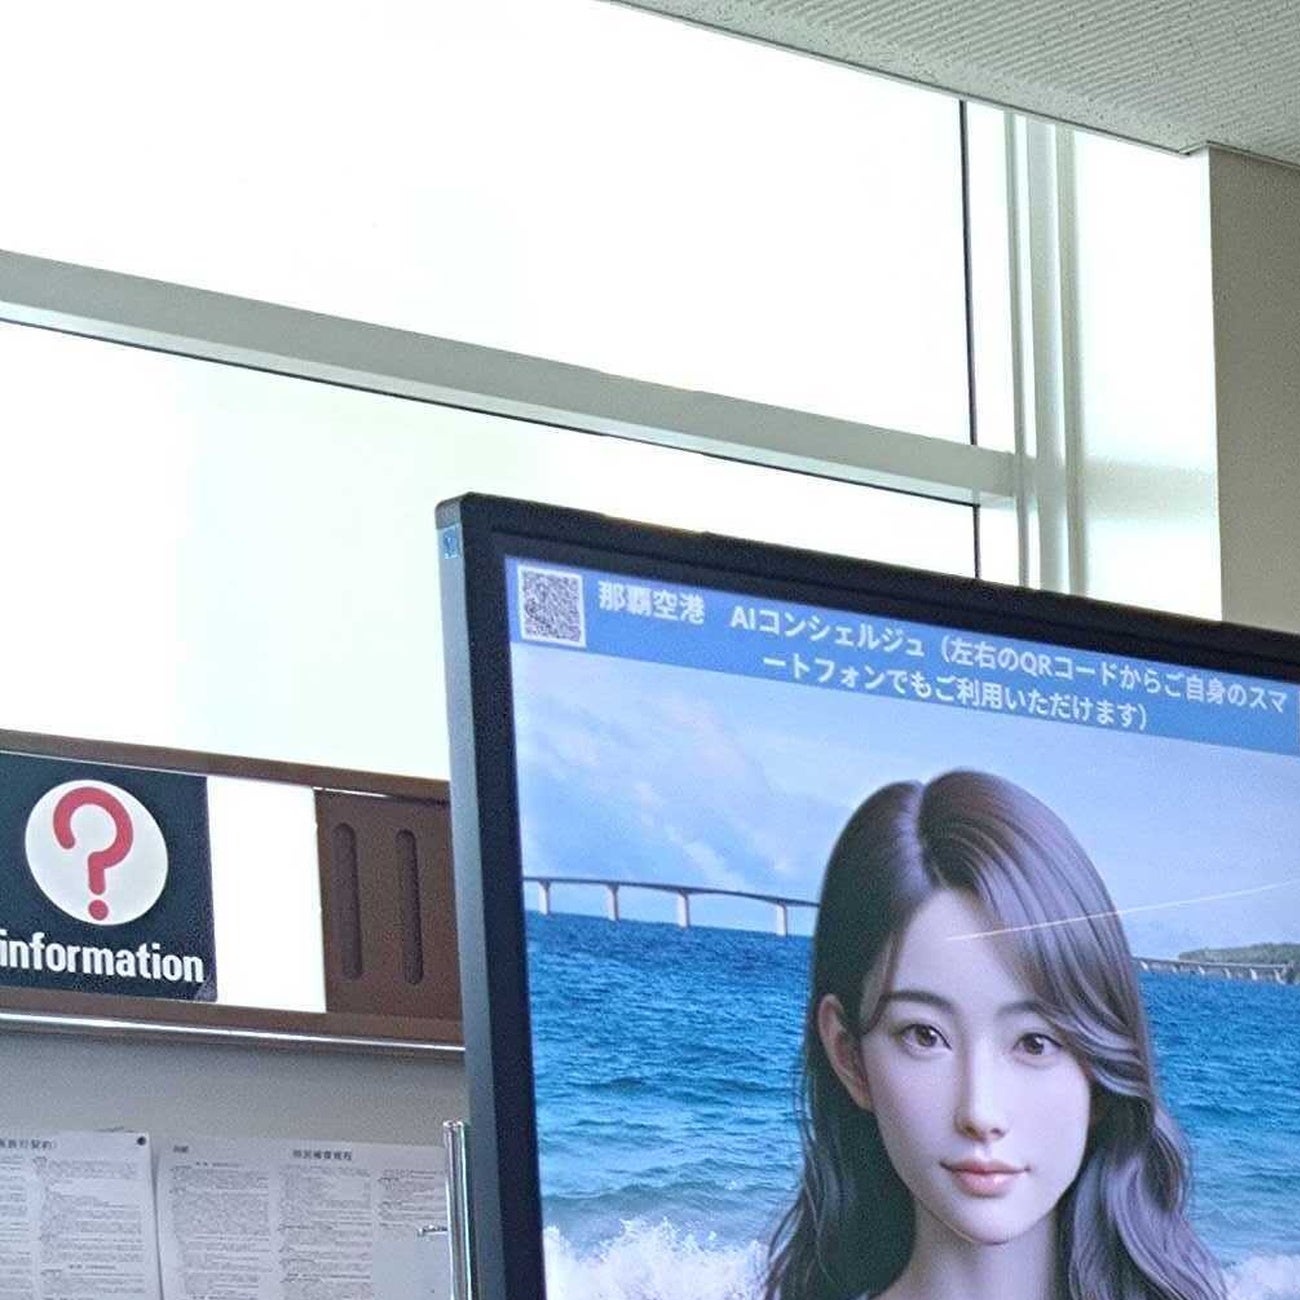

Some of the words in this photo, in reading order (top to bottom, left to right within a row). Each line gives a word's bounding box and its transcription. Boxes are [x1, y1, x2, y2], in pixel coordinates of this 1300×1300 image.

[598, 580, 705, 625] 那覇空港
[0, 930, 204, 984] information
